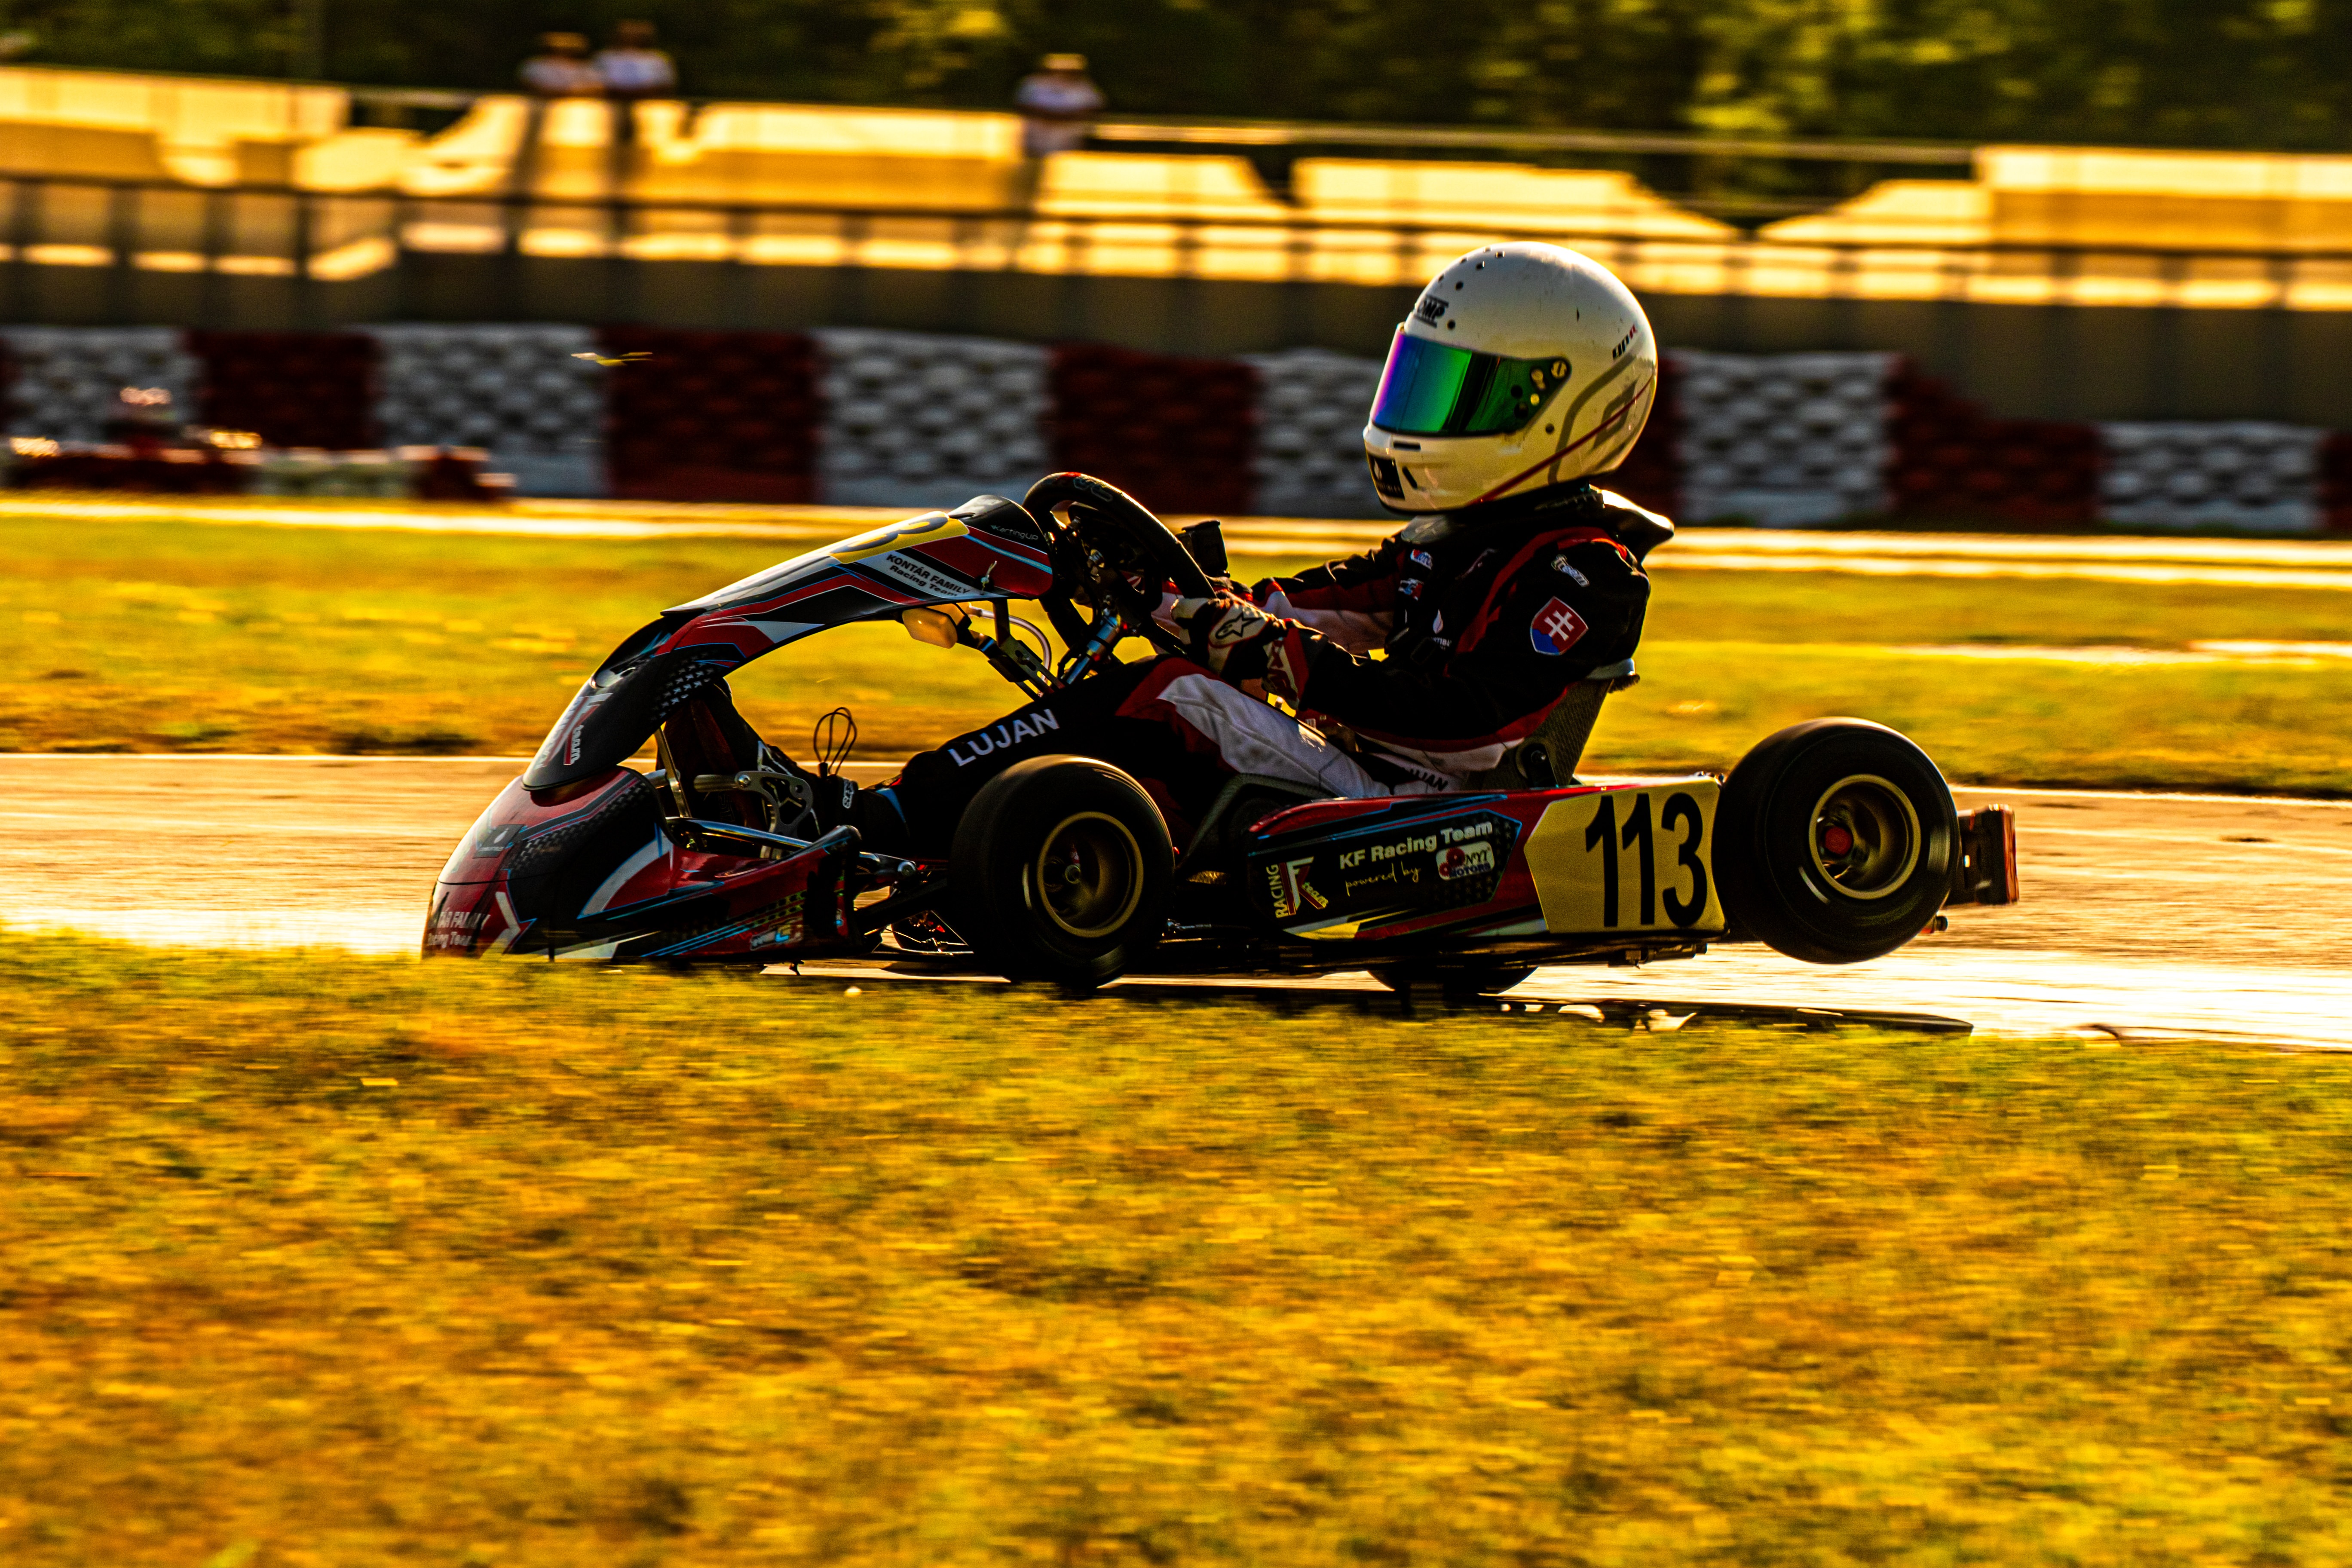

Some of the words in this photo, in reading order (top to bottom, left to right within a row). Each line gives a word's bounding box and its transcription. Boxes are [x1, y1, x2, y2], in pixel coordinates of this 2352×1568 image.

[886, 554, 931, 579] KONTÁR
[930, 575, 970, 594] FAMILY
[889, 565, 926, 586] Racing
[929, 584, 958, 597] Team
[947, 709, 1060, 766] LUJAN
[1339, 848, 1366, 870] KF
[1371, 835, 1437, 862] Racing
[1440, 821, 1493, 845] Team
[1585, 792, 1707, 927] 113
[1265, 864, 1289, 918] RACING
[1345, 862, 1398, 897] powered
[1401, 860, 1422, 883] by
